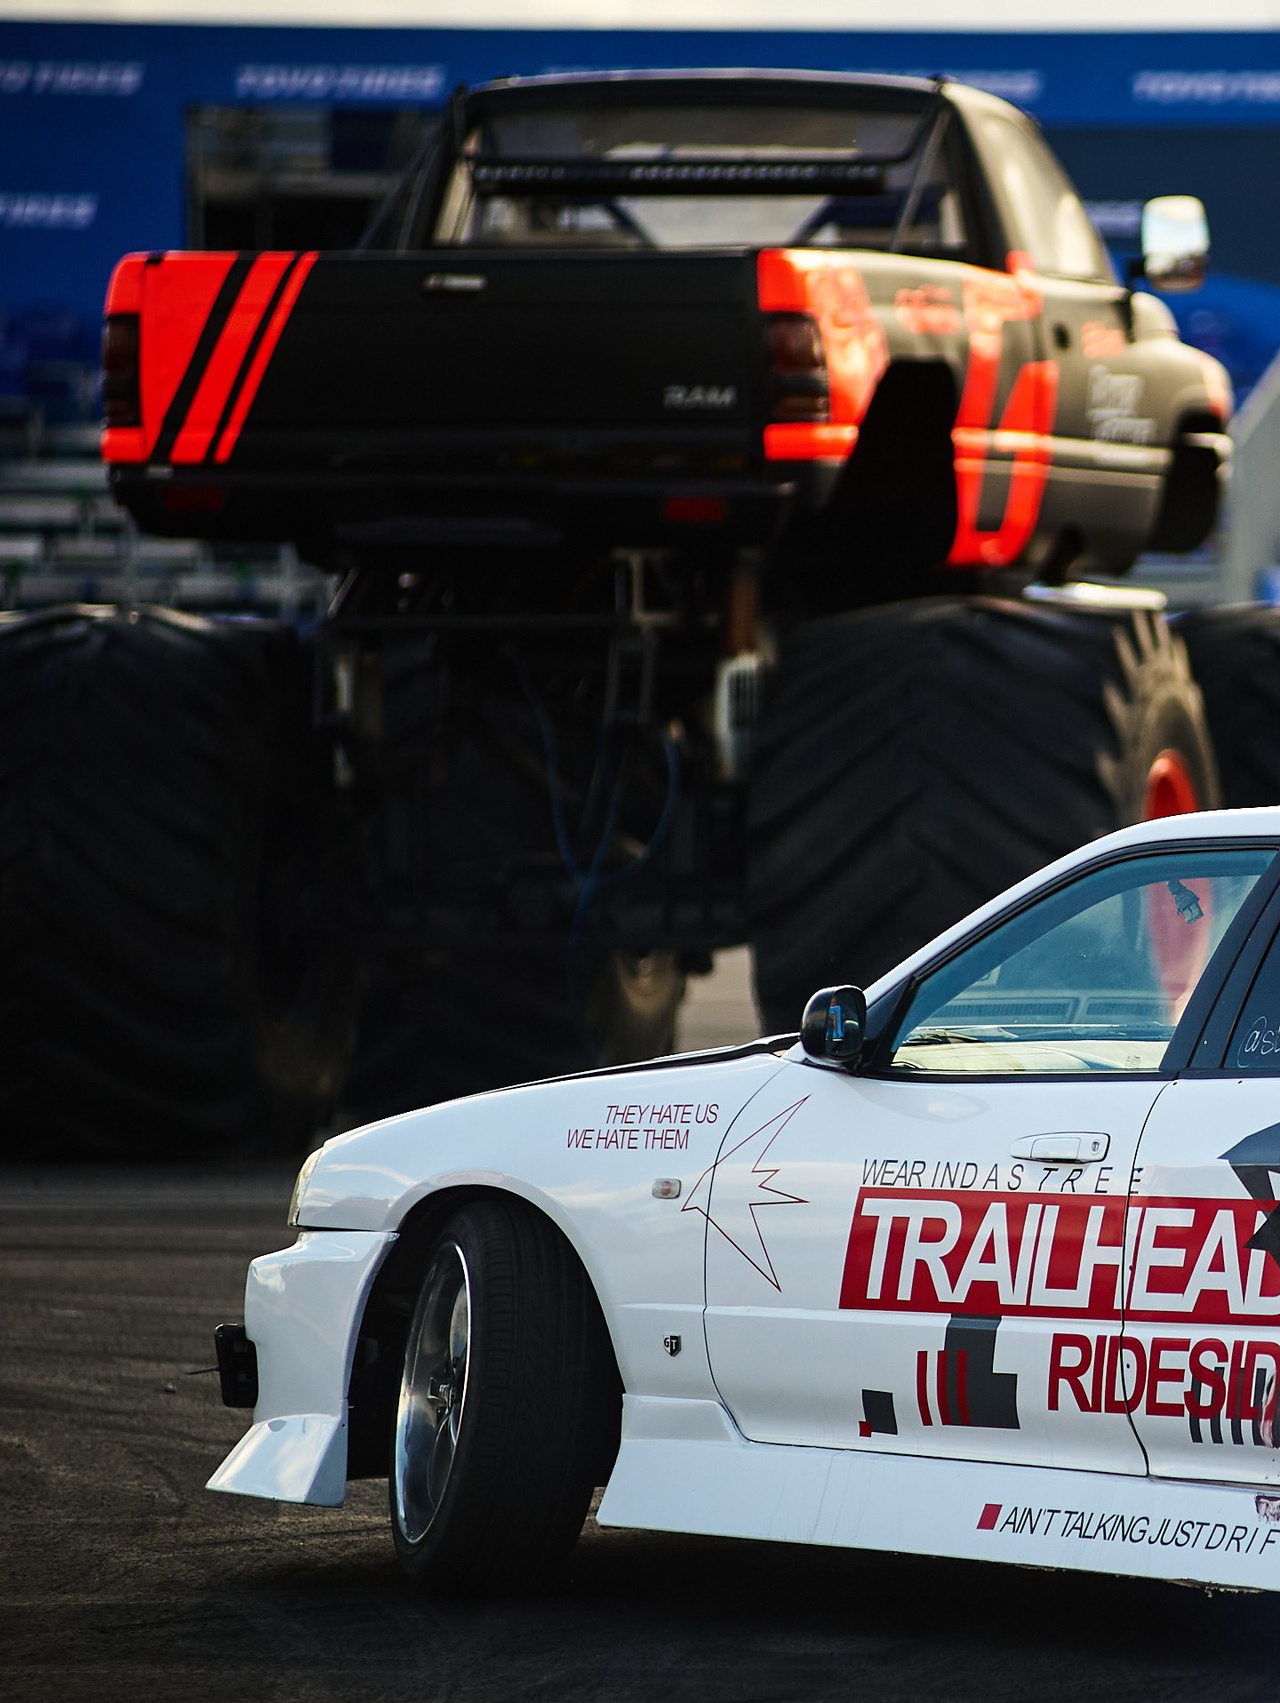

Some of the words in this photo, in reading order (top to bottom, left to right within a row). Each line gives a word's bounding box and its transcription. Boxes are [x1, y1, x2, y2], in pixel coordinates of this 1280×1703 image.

[606, 1104, 650, 1124] THEY
[649, 1104, 693, 1124] HATE
[695, 1103, 719, 1124] US
[567, 1129, 595, 1149] WE
[596, 1129, 640, 1149] HATE
[643, 1129, 690, 1149] THEM
[862, 1158, 926, 1188] WEAR
[663, 1337, 678, 1350] GT
[999, 1506, 1061, 1535] AIN'T
[1063, 1510, 1149, 1544] TALKING
[1147, 1519, 1210, 1549] JUST
